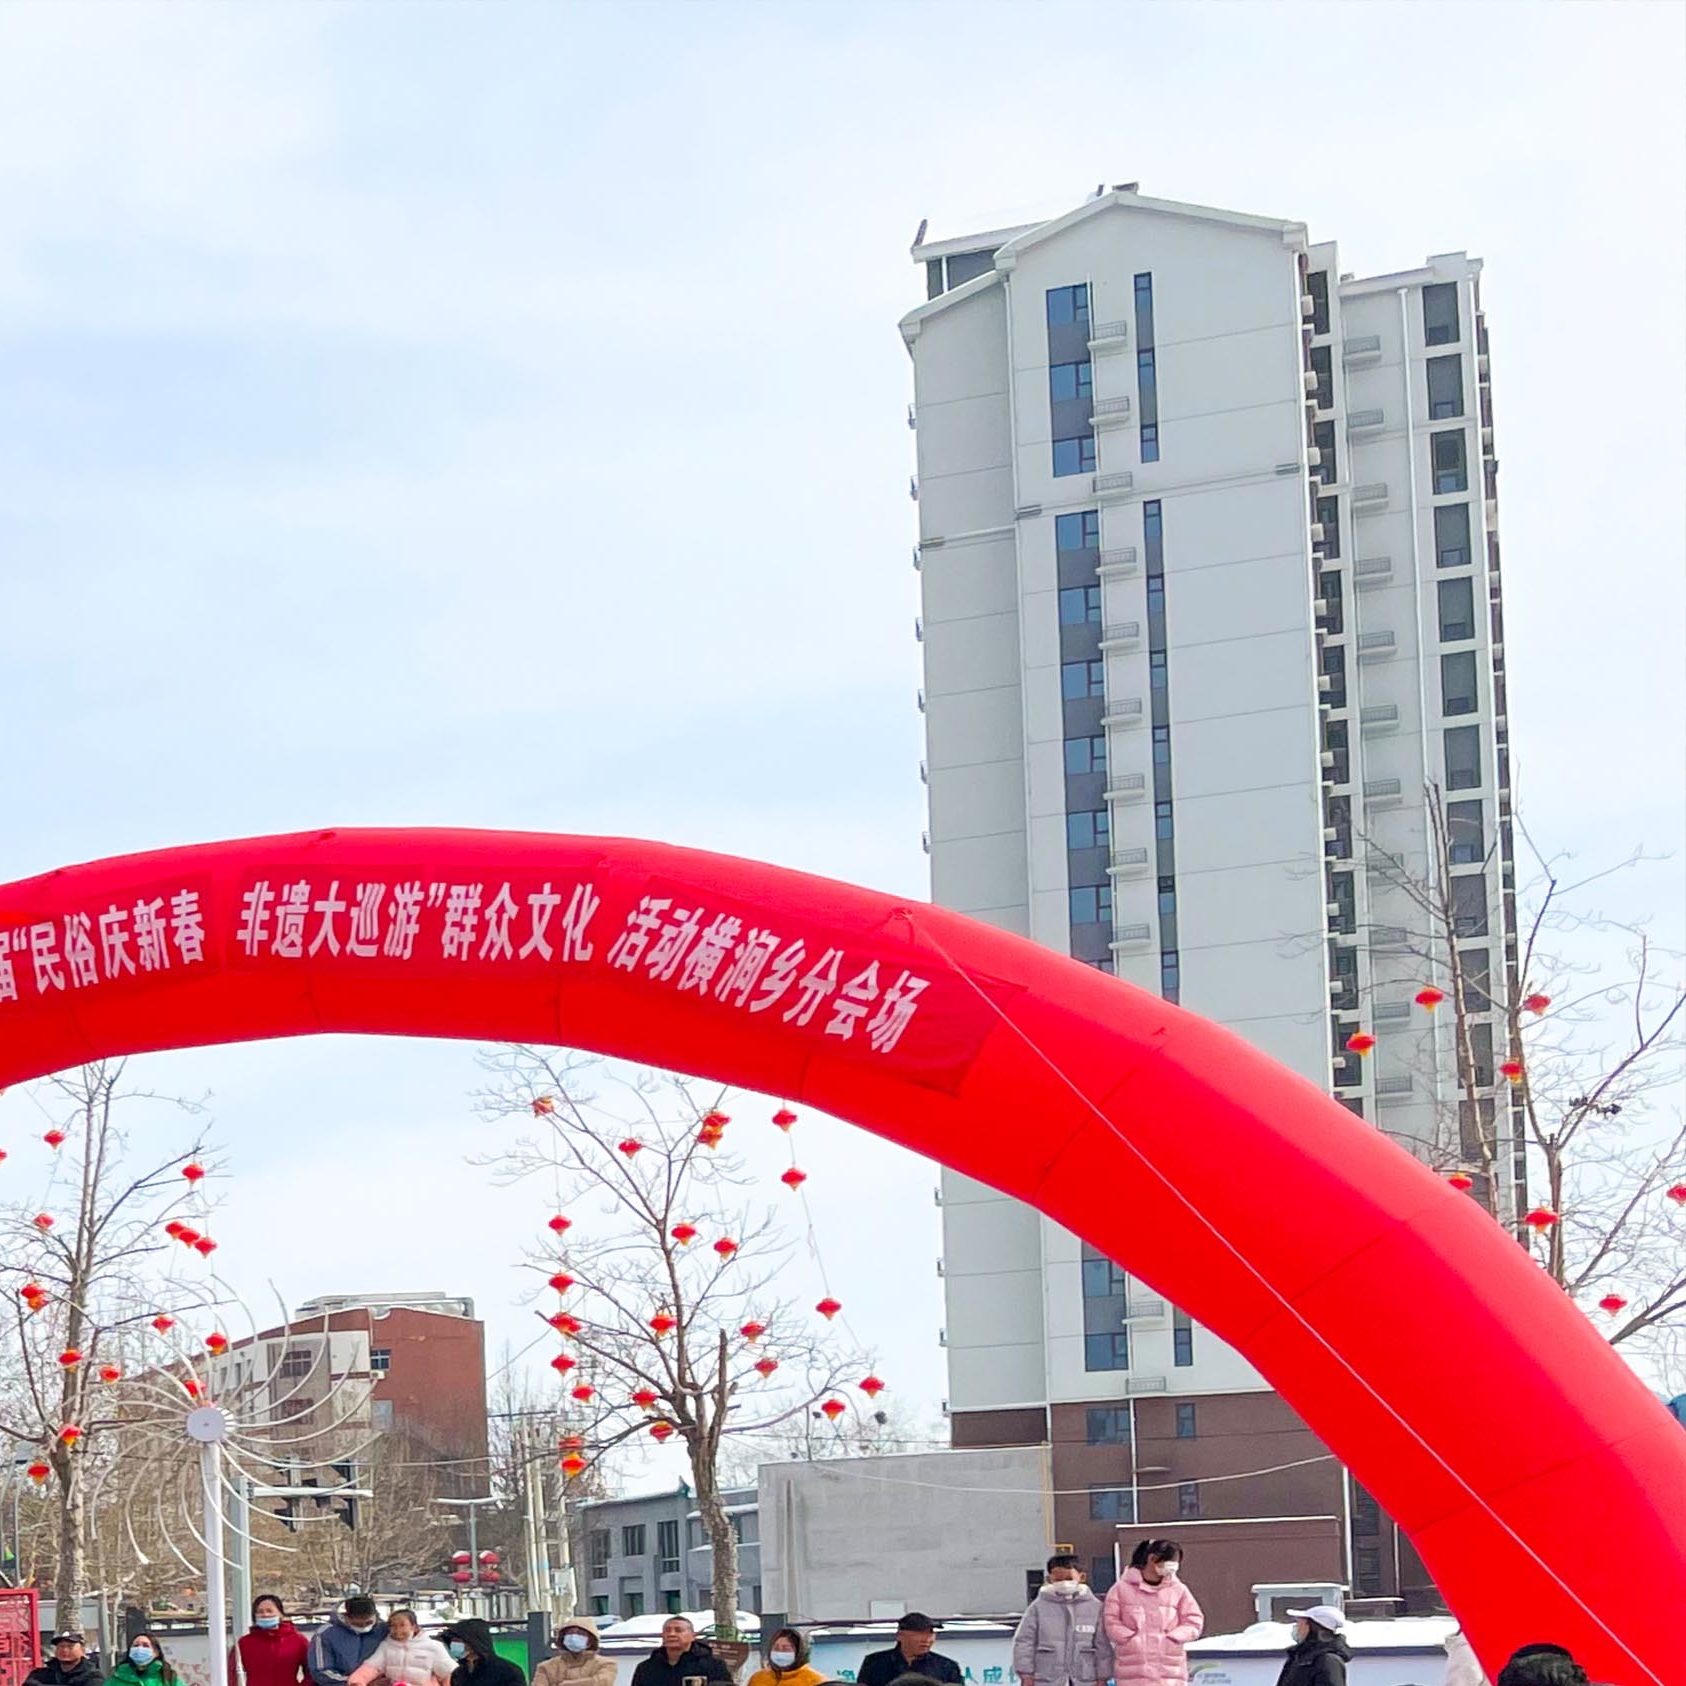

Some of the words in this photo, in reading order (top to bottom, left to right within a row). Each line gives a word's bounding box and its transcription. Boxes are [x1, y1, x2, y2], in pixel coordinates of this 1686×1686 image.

[236, 879, 600, 961] 非遗大巡游”群众文化
[607, 895, 931, 1055] 活动横涧乡分会场
